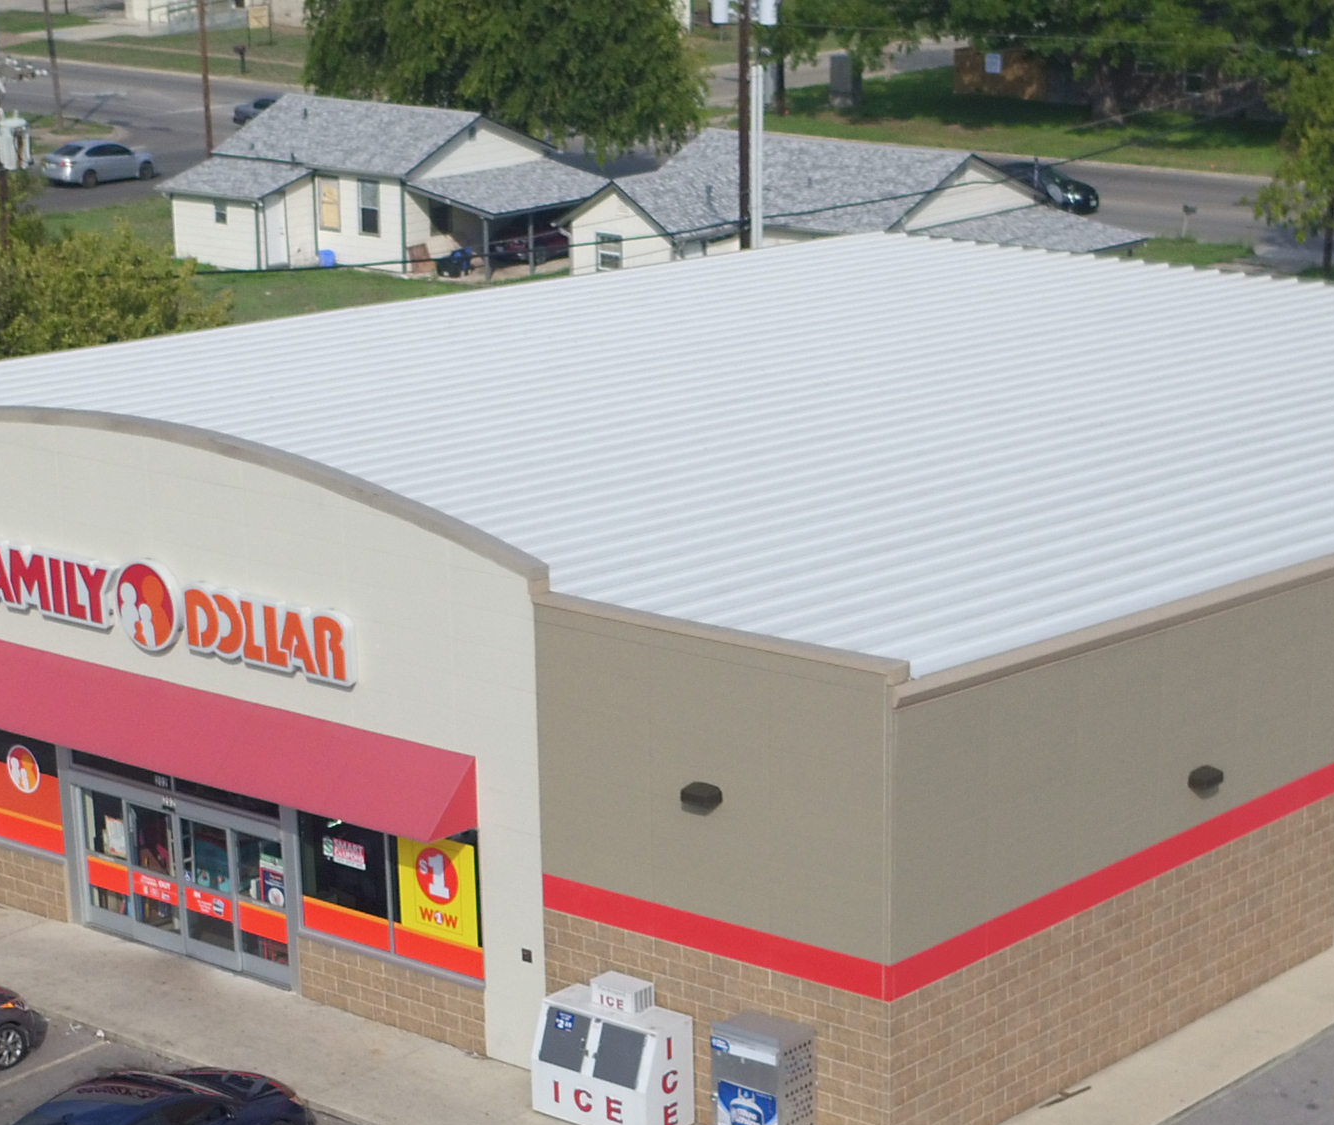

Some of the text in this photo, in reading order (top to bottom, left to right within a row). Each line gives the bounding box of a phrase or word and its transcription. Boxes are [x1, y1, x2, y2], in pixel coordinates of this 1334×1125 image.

[184, 587, 347, 682] DOLLAR
[334, 839, 365, 855] SMART
[600, 994, 624, 1011] ICE
[553, 1080, 624, 1124] ICE
